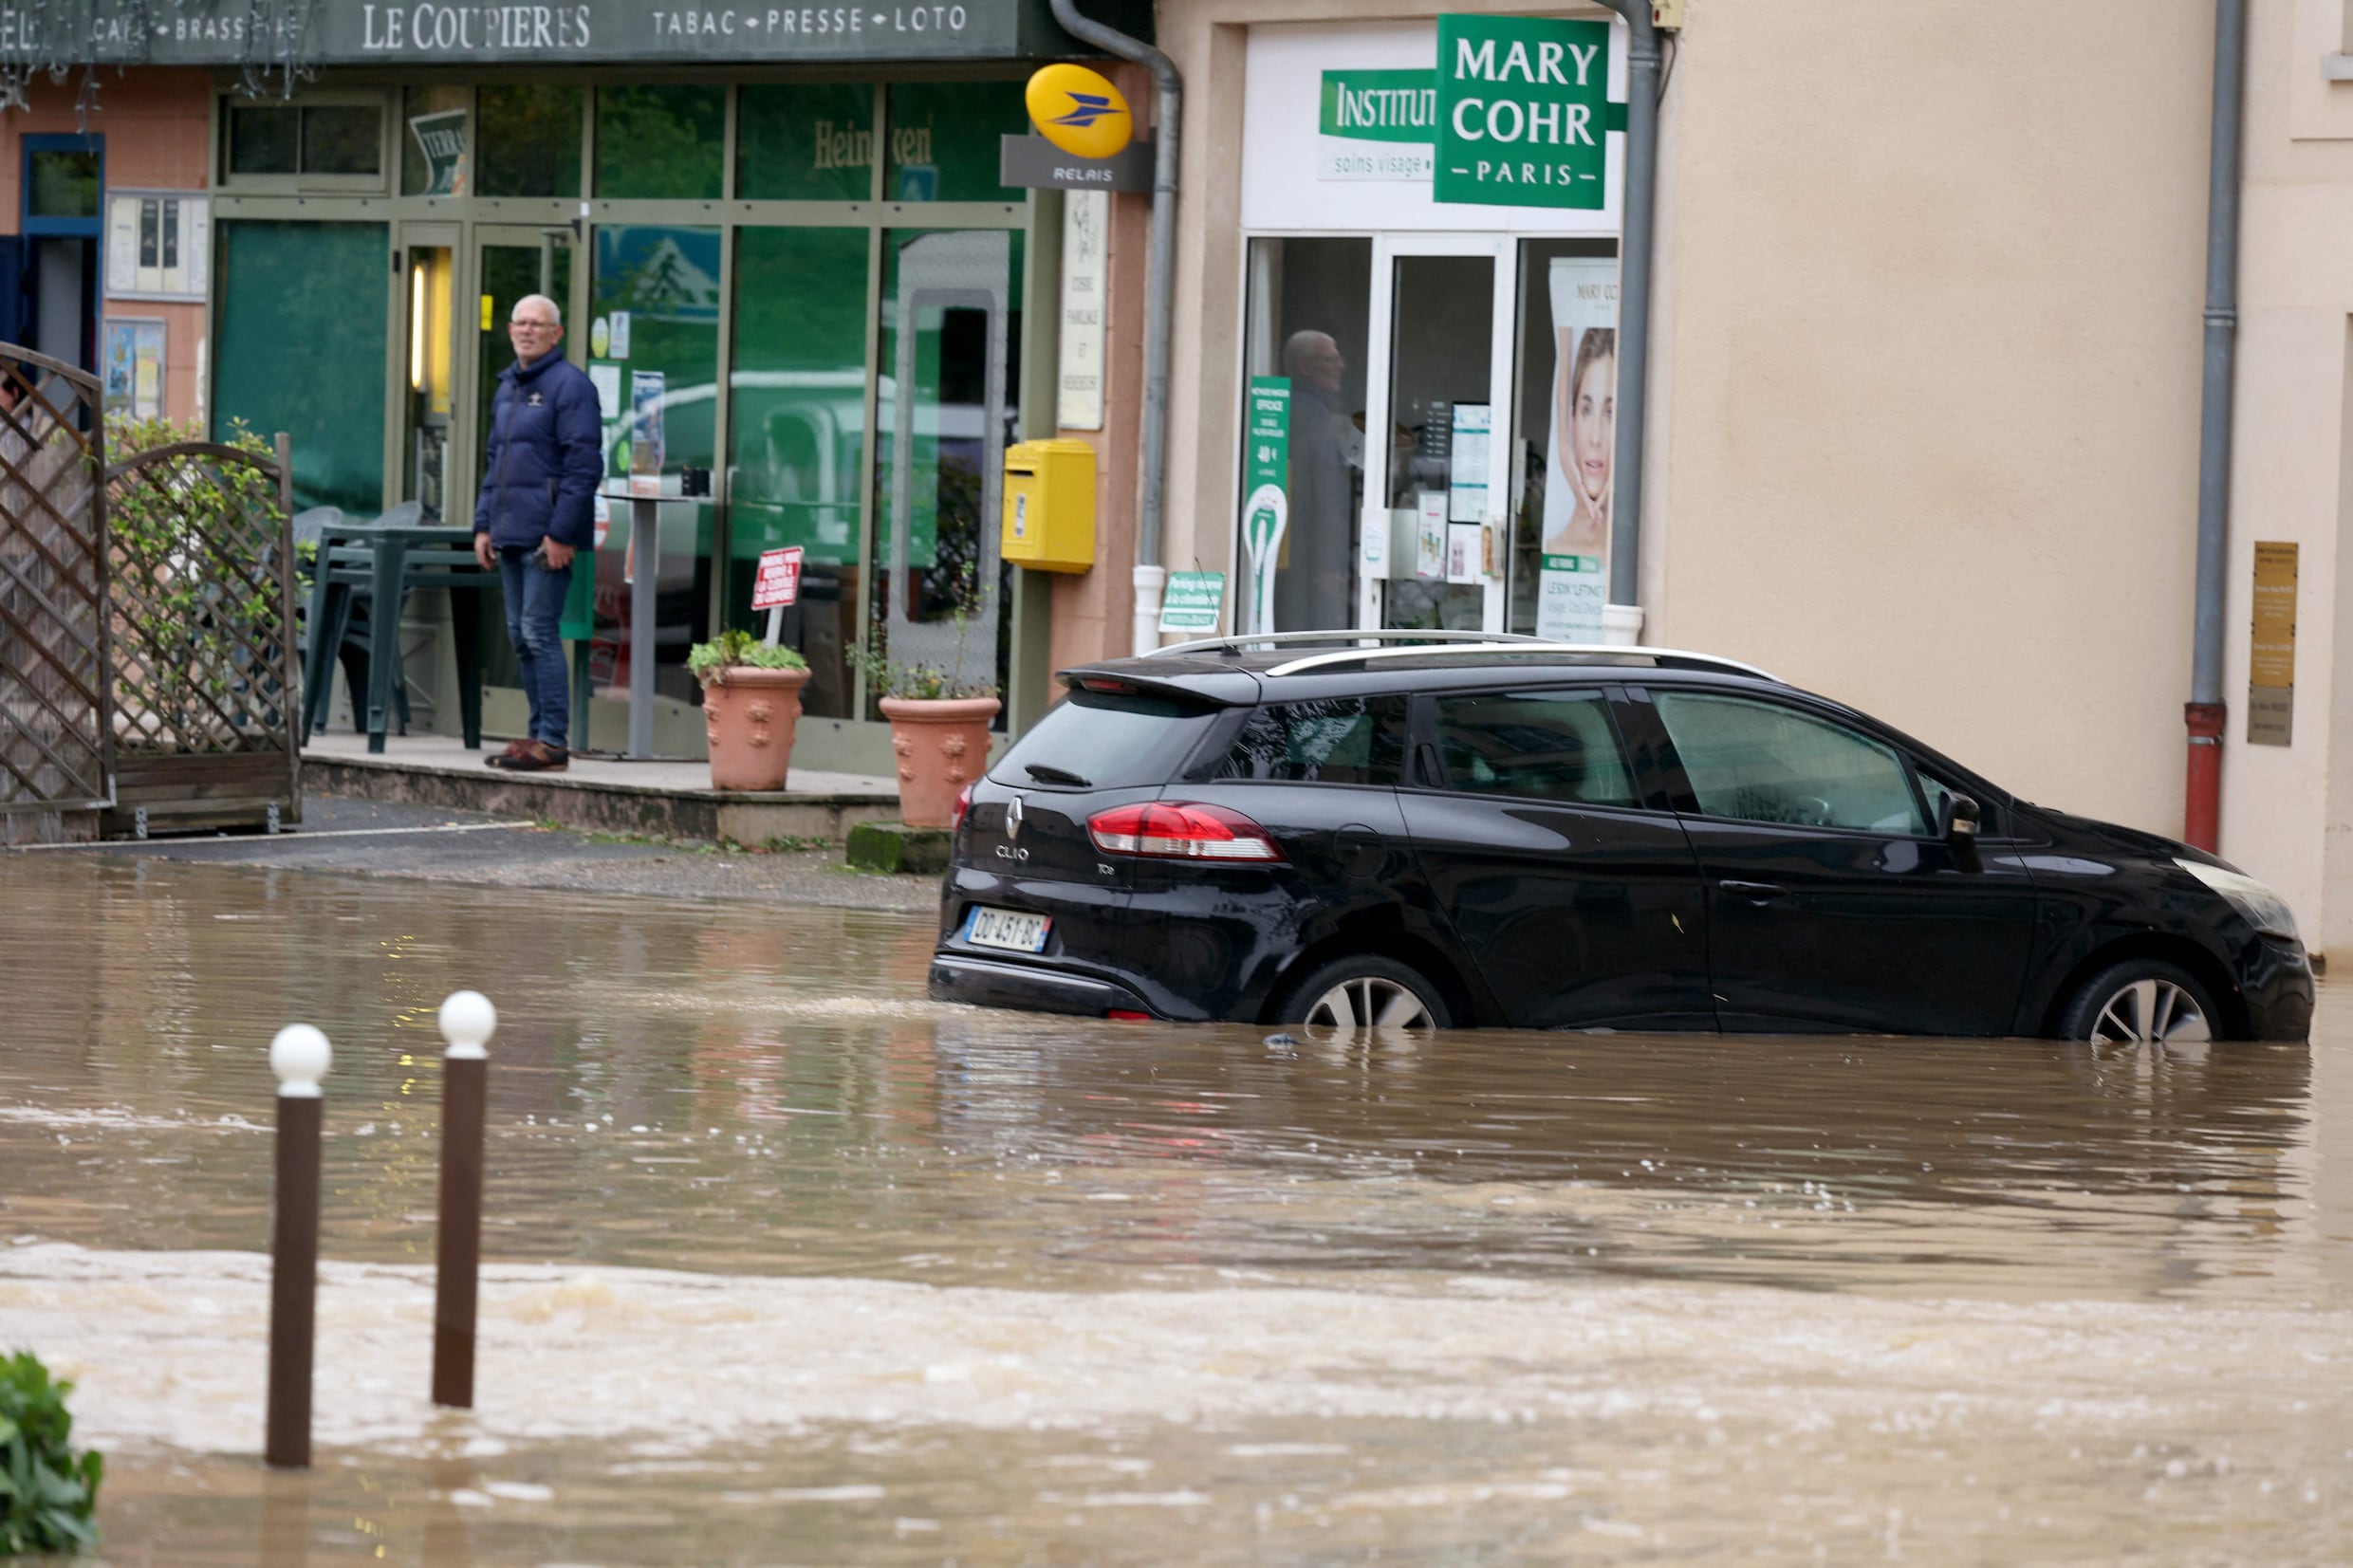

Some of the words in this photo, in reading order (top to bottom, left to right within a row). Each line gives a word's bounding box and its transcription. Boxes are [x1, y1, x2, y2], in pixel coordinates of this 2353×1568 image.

[176, 17, 297, 40] BRASSIE
[364, 5, 403, 47] LE
[412, 4, 590, 48] COUPIERES
[654, 10, 735, 34] TABAC
[767, 9, 862, 32] PRESSE
[895, 6, 966, 30] LOTO
[1454, 38, 1599, 85] MARY
[1453, 98, 1596, 146] COHR
[1053, 167, 1114, 182] RELAIS
[1335, 154, 1373, 174] soins
[1379, 151, 1421, 177] visage
[1476, 160, 1571, 185] PARIS
[995, 844, 1029, 861] CLIO
